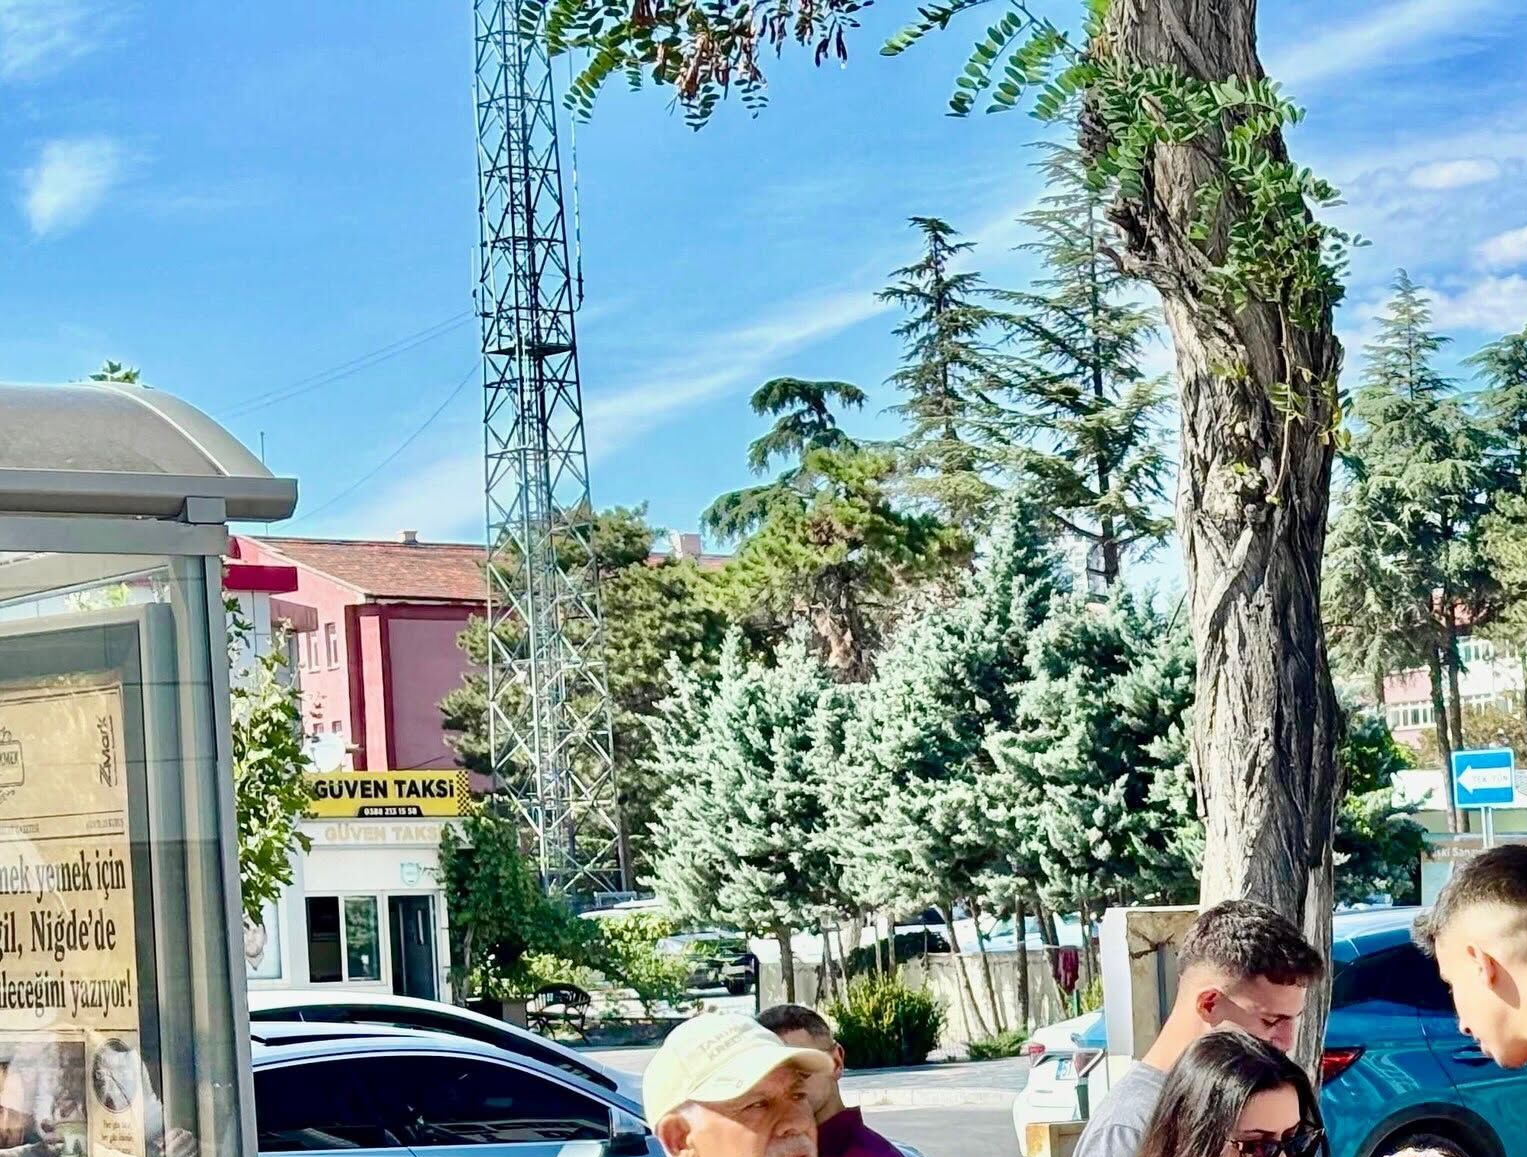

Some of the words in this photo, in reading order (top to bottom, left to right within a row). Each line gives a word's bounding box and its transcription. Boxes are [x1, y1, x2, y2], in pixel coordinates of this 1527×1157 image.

[314, 780, 388, 799] GÜVEN
[394, 780, 455, 799] TAKSİ
[325, 823, 386, 841] GÜVEN
[36, 849, 93, 904] yemek
[95, 848, 126, 900] için
[30, 907, 116, 962] Niğde'de
[70, 968, 132, 1018] yazıyor!
